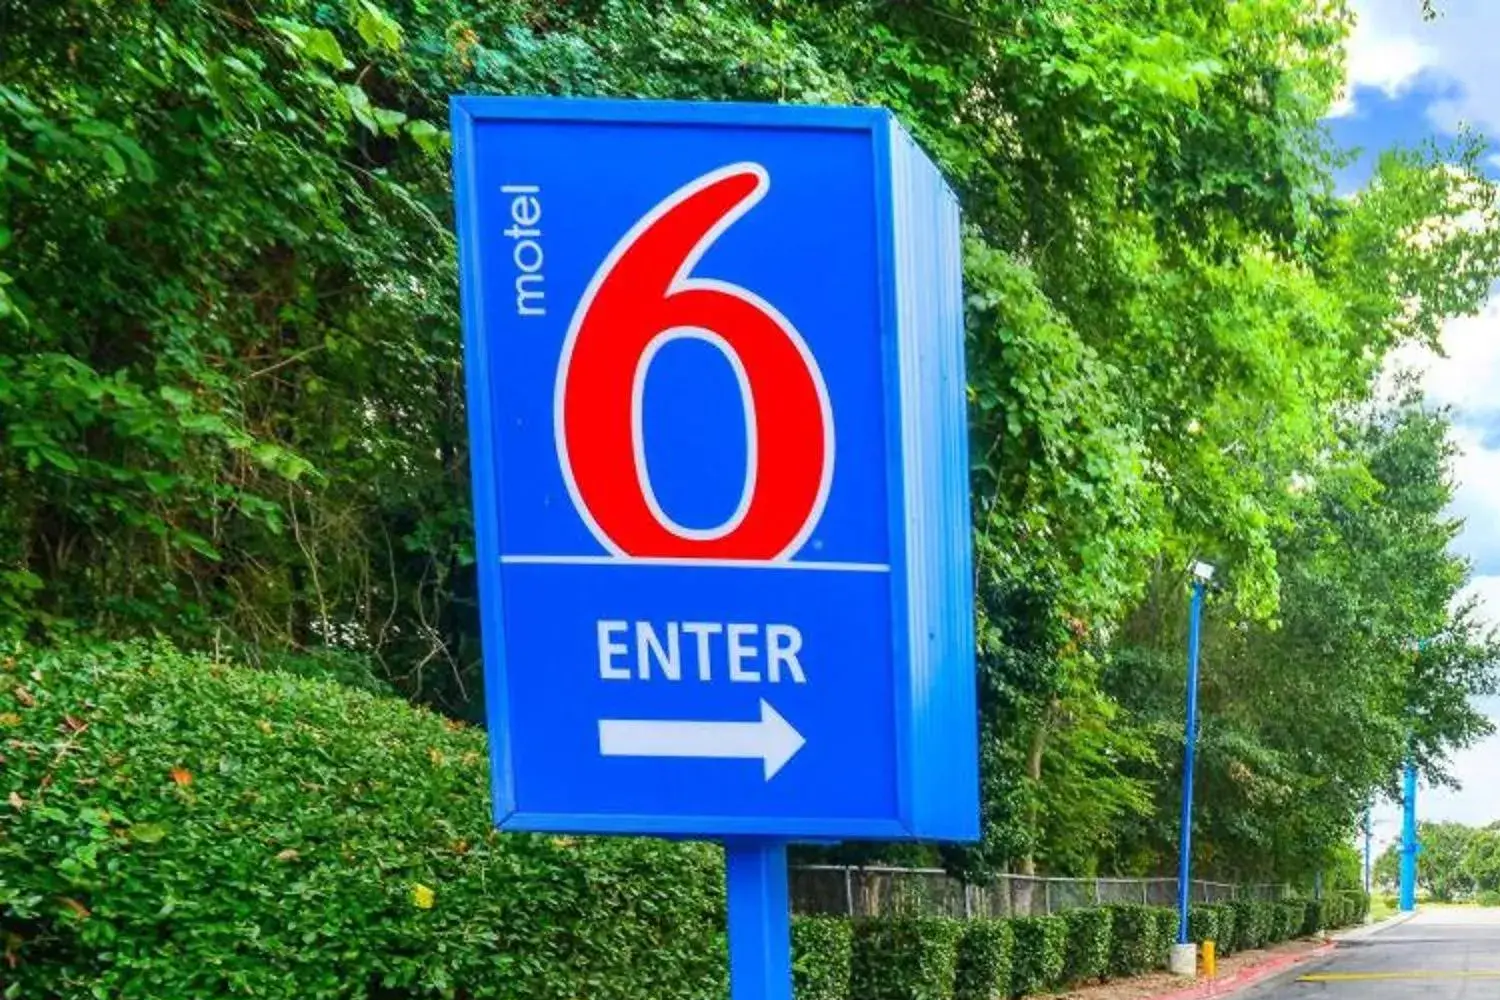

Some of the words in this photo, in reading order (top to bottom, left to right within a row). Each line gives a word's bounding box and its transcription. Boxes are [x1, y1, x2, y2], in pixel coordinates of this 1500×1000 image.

[500, 185, 546, 316] motel
[553, 161, 835, 563] 6
[597, 619, 807, 683] ENTER
